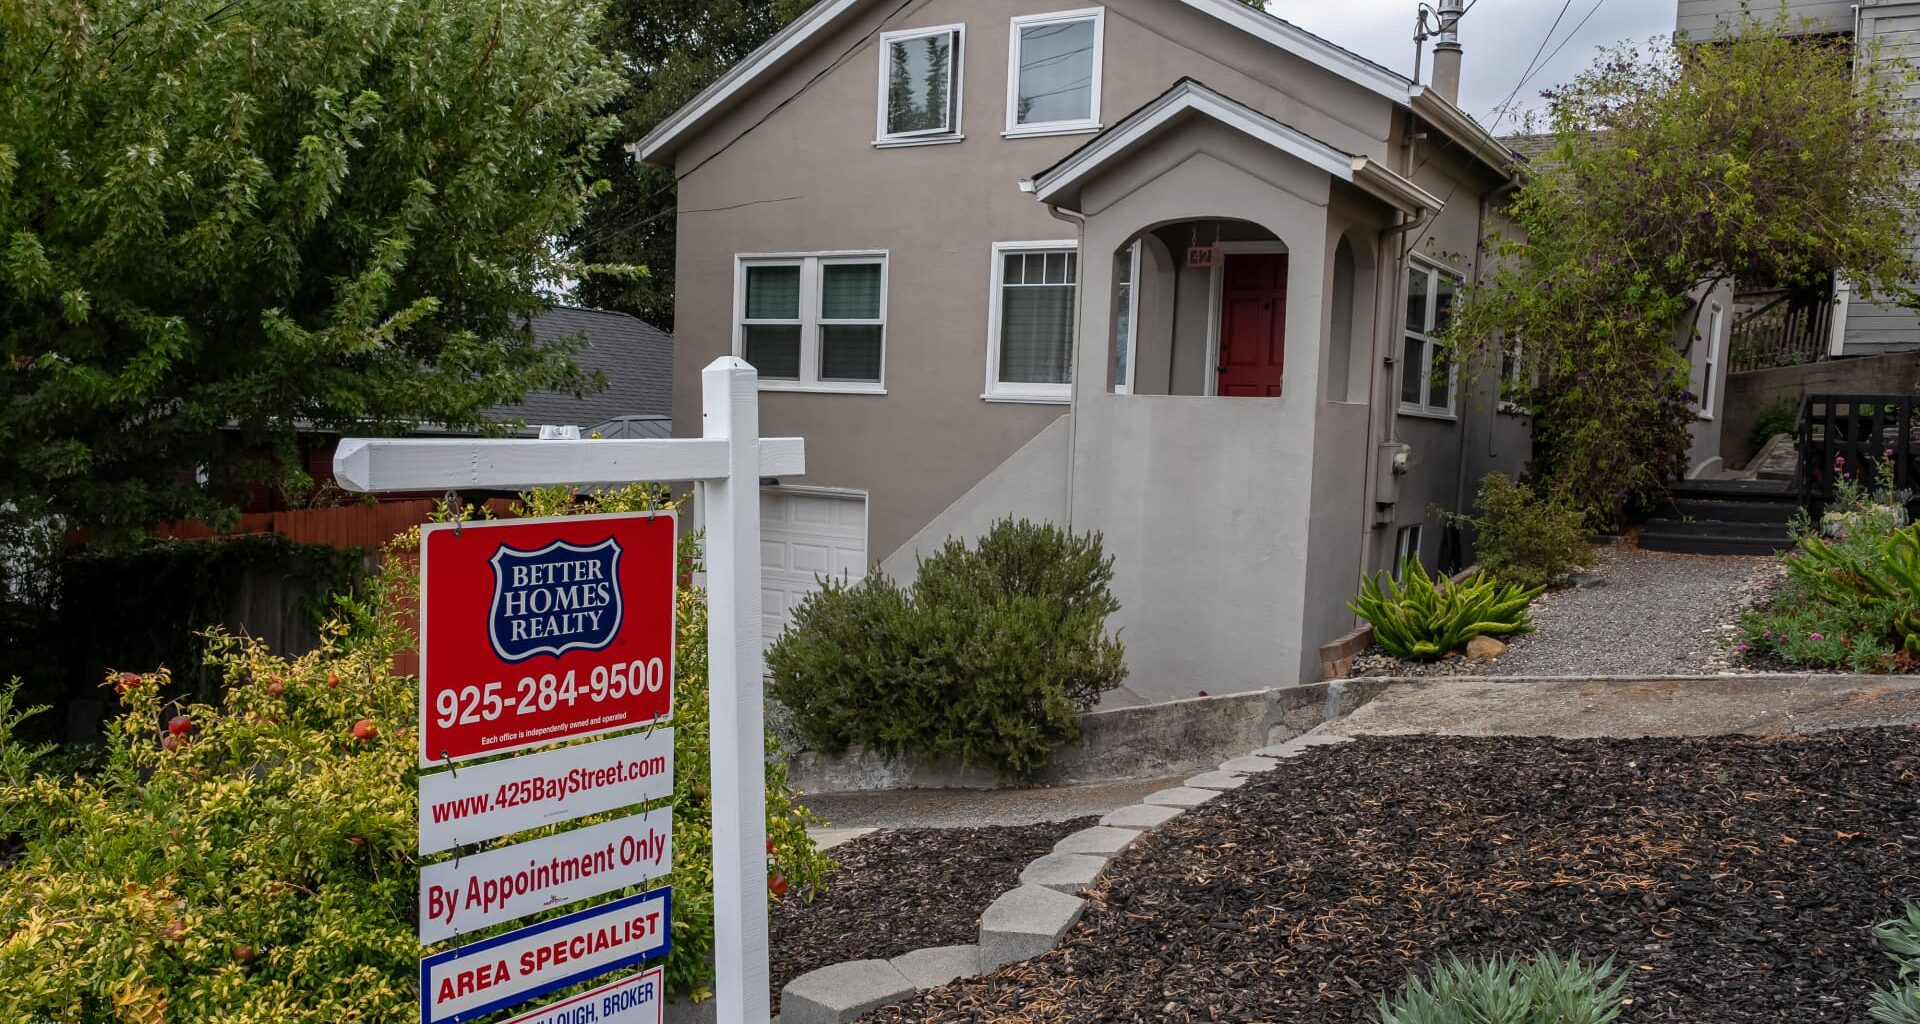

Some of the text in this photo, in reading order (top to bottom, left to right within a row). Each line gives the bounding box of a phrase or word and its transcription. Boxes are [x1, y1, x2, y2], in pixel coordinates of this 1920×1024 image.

[511, 559, 603, 588] BETTER
[503, 581, 610, 617] HOMES
[510, 610, 603, 641] REALTY
[436, 657, 664, 729] 925-284-9500
[481, 736, 498, 746] Each
[499, 732, 518, 742] office
[525, 721, 569, 738] independently
[569, 718, 589, 730] owned
[590, 716, 602, 726] and
[602, 711, 627, 725] operated
[432, 755, 666, 824] www.425BayStreet.com
[428, 828, 666, 926] By Appointment Only
[437, 912, 660, 1004] AREA SPECIALIST
[603, 981, 654, 1018] BROKER
